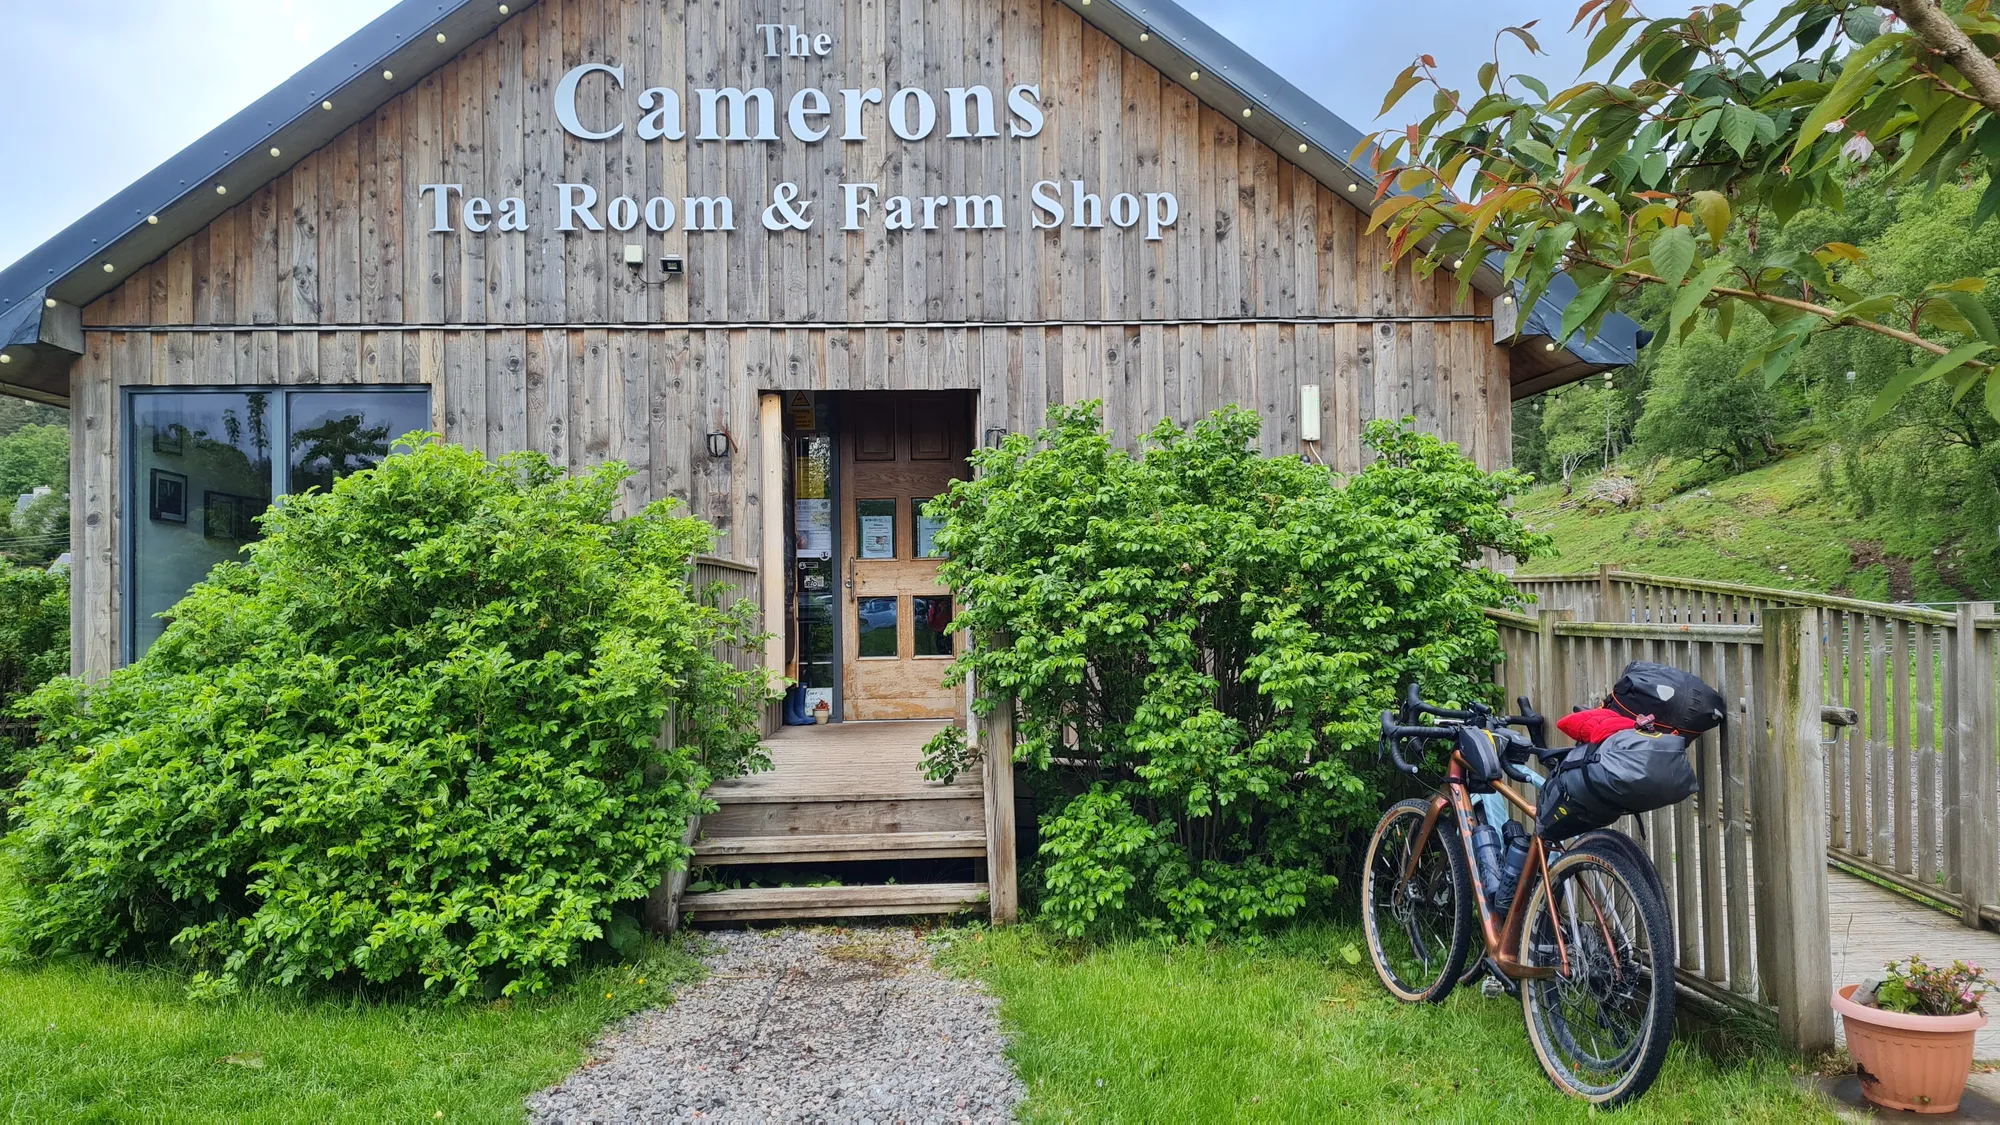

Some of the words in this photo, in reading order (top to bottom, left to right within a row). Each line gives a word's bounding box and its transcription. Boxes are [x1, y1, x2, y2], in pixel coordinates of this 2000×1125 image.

[756, 23, 832, 57] The
[553, 63, 1045, 142] Camerons
[419, 184, 530, 233] Tea
[554, 183, 735, 233] Room
[762, 182, 815, 231] &
[839, 183, 1006, 231] Farm
[1032, 180, 1179, 240] Shop
